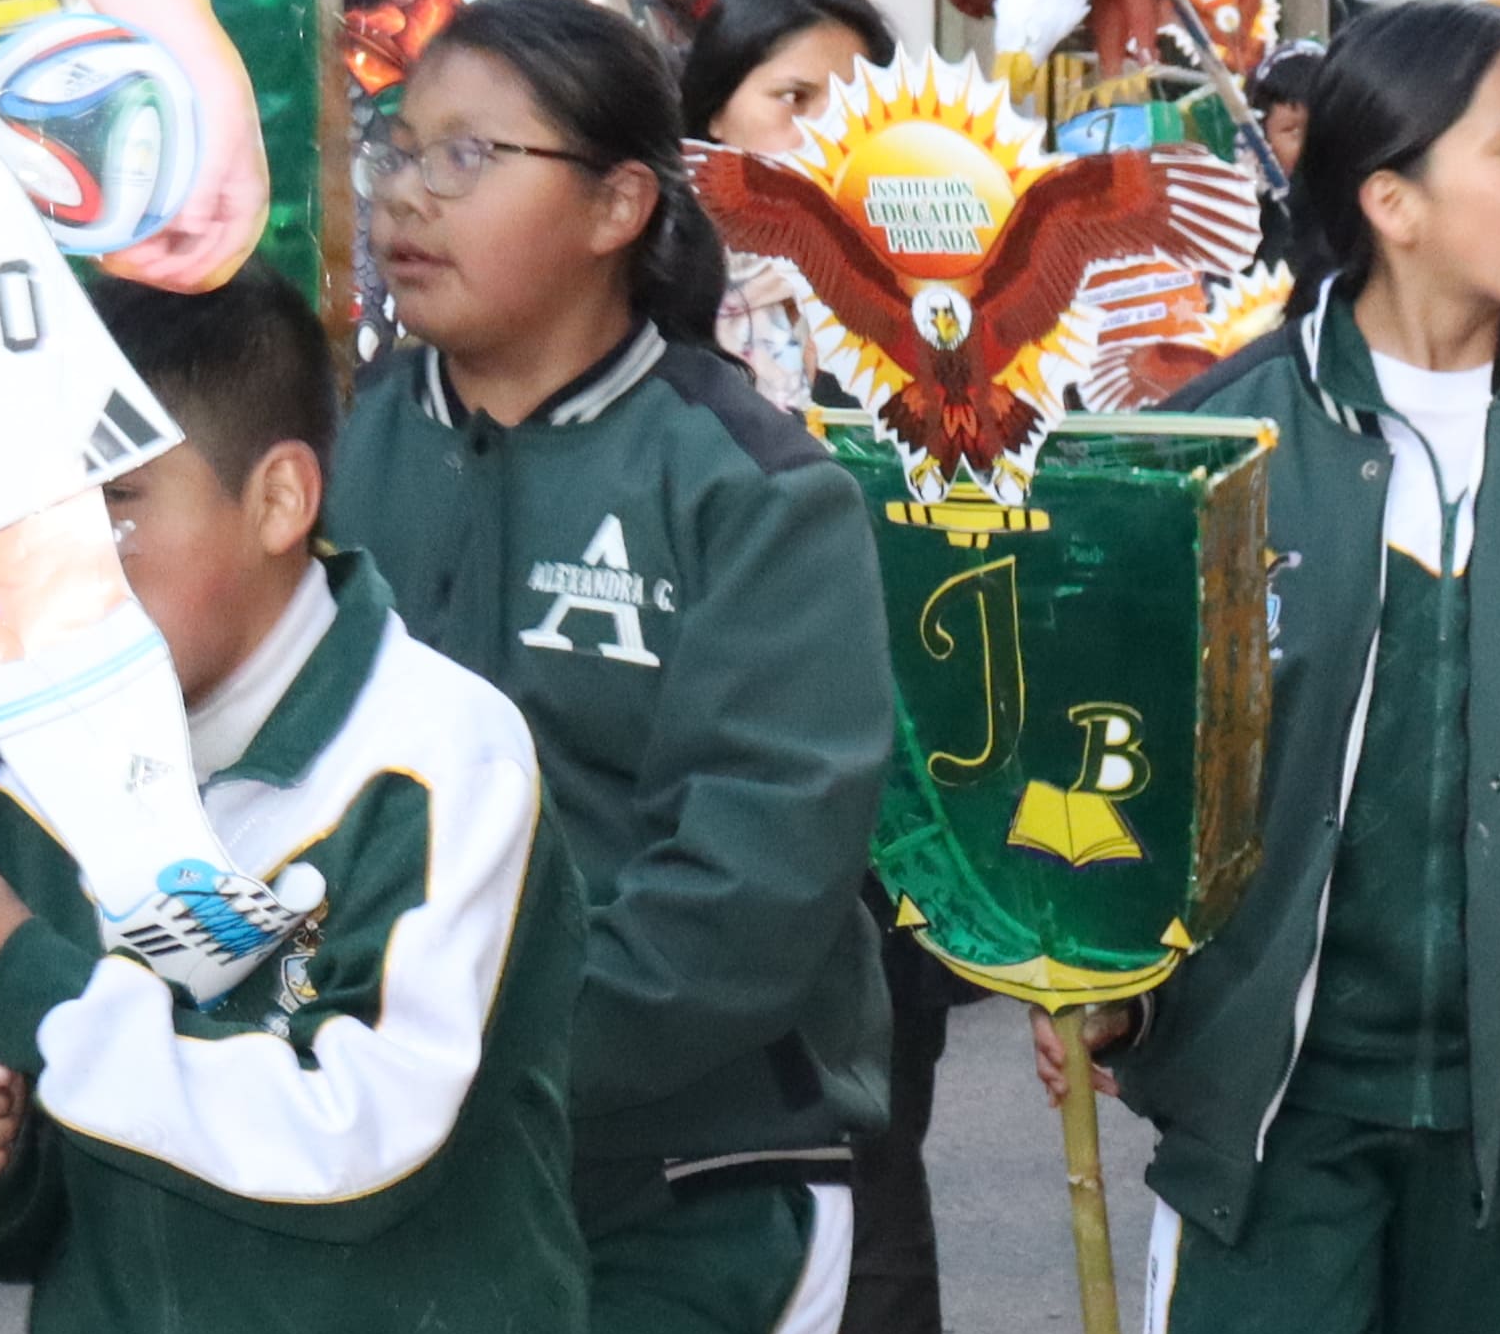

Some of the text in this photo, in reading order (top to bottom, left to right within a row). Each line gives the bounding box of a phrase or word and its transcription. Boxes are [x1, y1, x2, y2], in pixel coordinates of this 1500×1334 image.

[866, 202, 992, 225] EDUCATIVA
[888, 227, 980, 253] PRIVADA
[527, 561, 644, 605] ALEXANDRA
[919, 554, 1153, 802] J B
